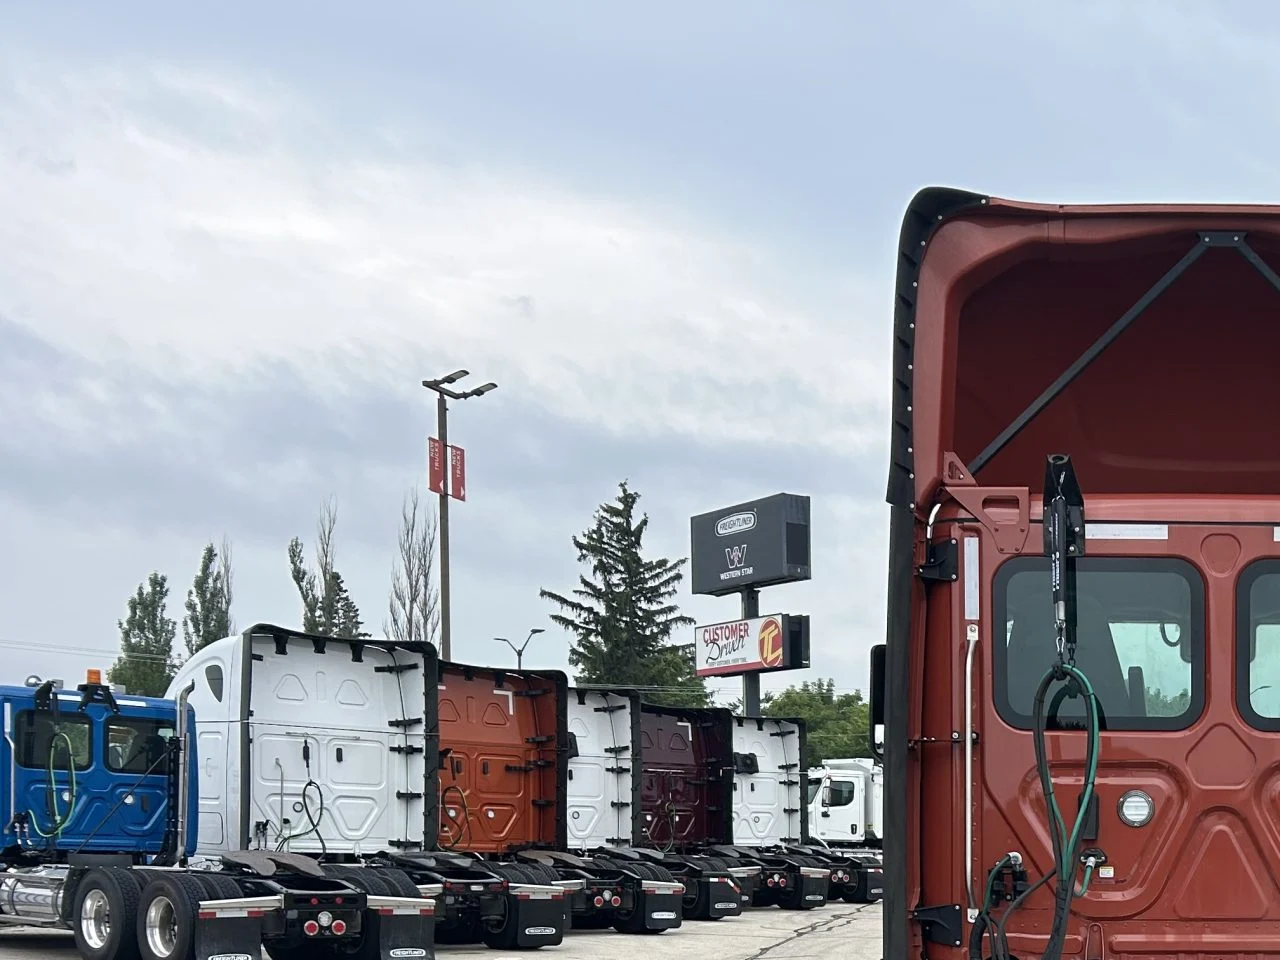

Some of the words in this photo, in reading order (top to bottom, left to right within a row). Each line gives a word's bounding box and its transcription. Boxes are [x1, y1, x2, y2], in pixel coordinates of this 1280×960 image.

[720, 516, 753, 531] FREIGHTLINER
[742, 567, 753, 576] STAR
[703, 622, 750, 644] CUSTOMER
[705, 635, 745, 665] Driven
